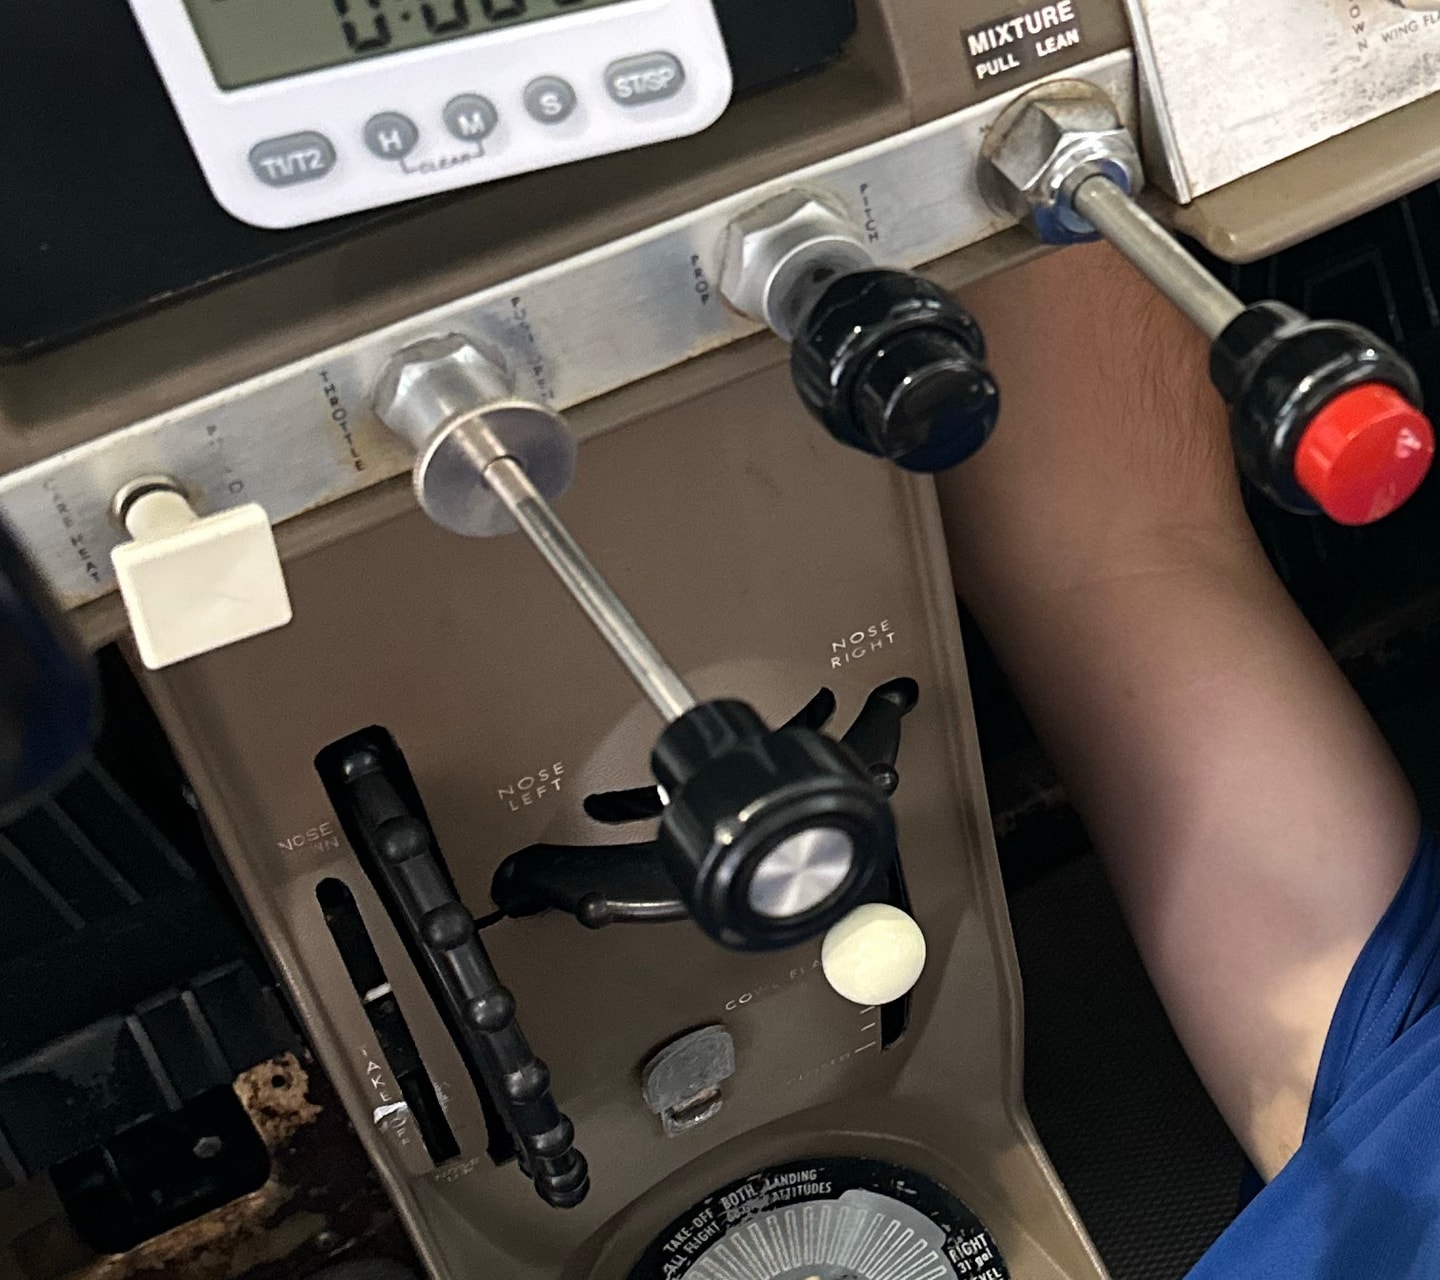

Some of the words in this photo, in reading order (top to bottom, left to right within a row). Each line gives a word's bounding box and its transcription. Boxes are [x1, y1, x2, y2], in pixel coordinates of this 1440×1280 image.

[1381, 19, 1420, 44] WING
[974, 52, 1021, 81] PULL
[1035, 28, 1081, 58] LEAN
[540, 92, 562, 115] S
[377, 127, 402, 152] H
[457, 110, 487, 136] M
[418, 153, 474, 175] CLEAR
[859, 182, 880, 245] PITCH
[689, 253, 711, 307] PROP
[318, 370, 367, 472] THROTTLE
[830, 631, 896, 670] RIGHT
[831, 619, 891, 653] NOSE
[497, 762, 565, 800] NOSE
[508, 778, 562, 811] LEFT
[277, 822, 334, 851] NOSE
[662, 1208, 714, 1252] TAKE-OFF
[720, 1183, 759, 1210] BOTH
[765, 1169, 818, 1190] LANDING
[683, 1221, 721, 1254] FLIGHT
[770, 1181, 832, 1203] ATTITUDES
[948, 1233, 988, 1263] RIGHT
[957, 1259, 972, 1274] 31
[974, 1247, 994, 1269] gal
